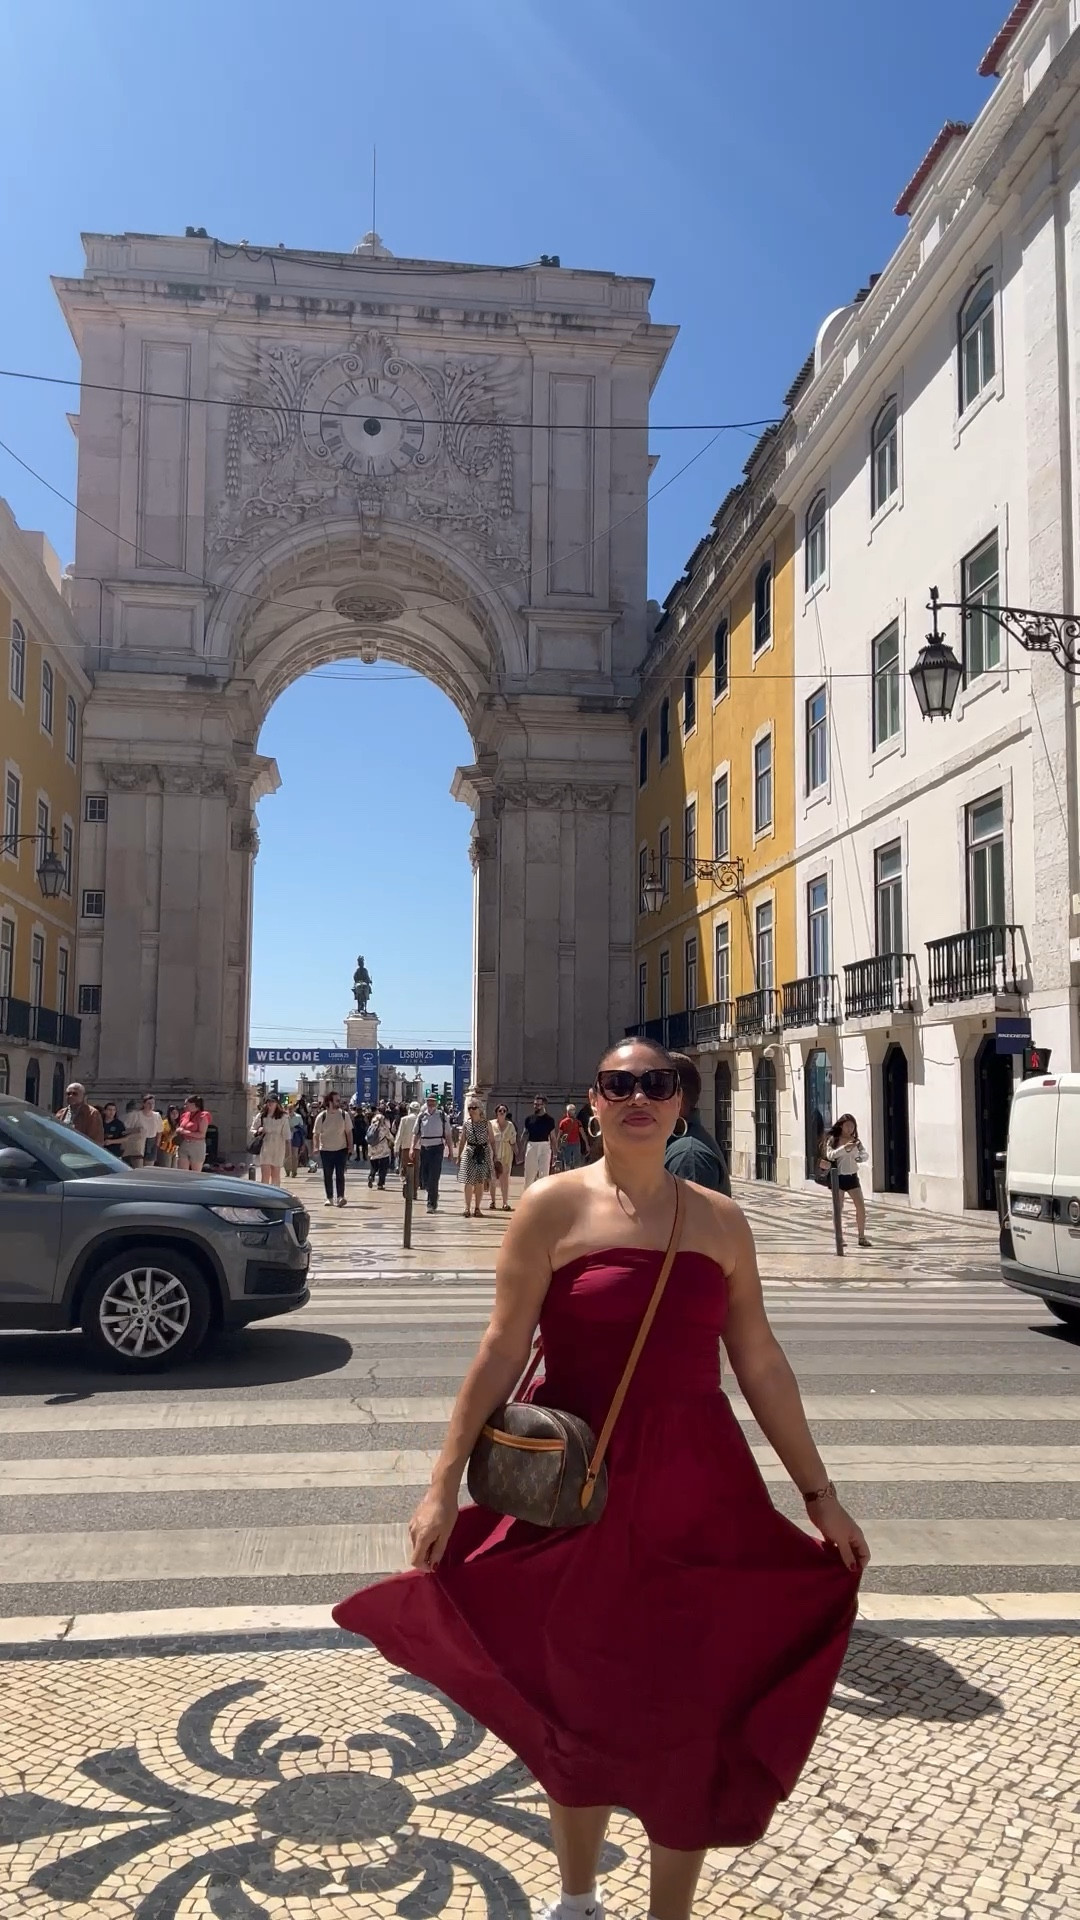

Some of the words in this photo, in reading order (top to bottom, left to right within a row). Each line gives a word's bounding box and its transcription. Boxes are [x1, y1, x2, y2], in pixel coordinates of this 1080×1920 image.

[256, 1051, 320, 1061] WELCOME
[399, 1050, 424, 1059] LISBON
[424, 1050, 433, 1059] 25
